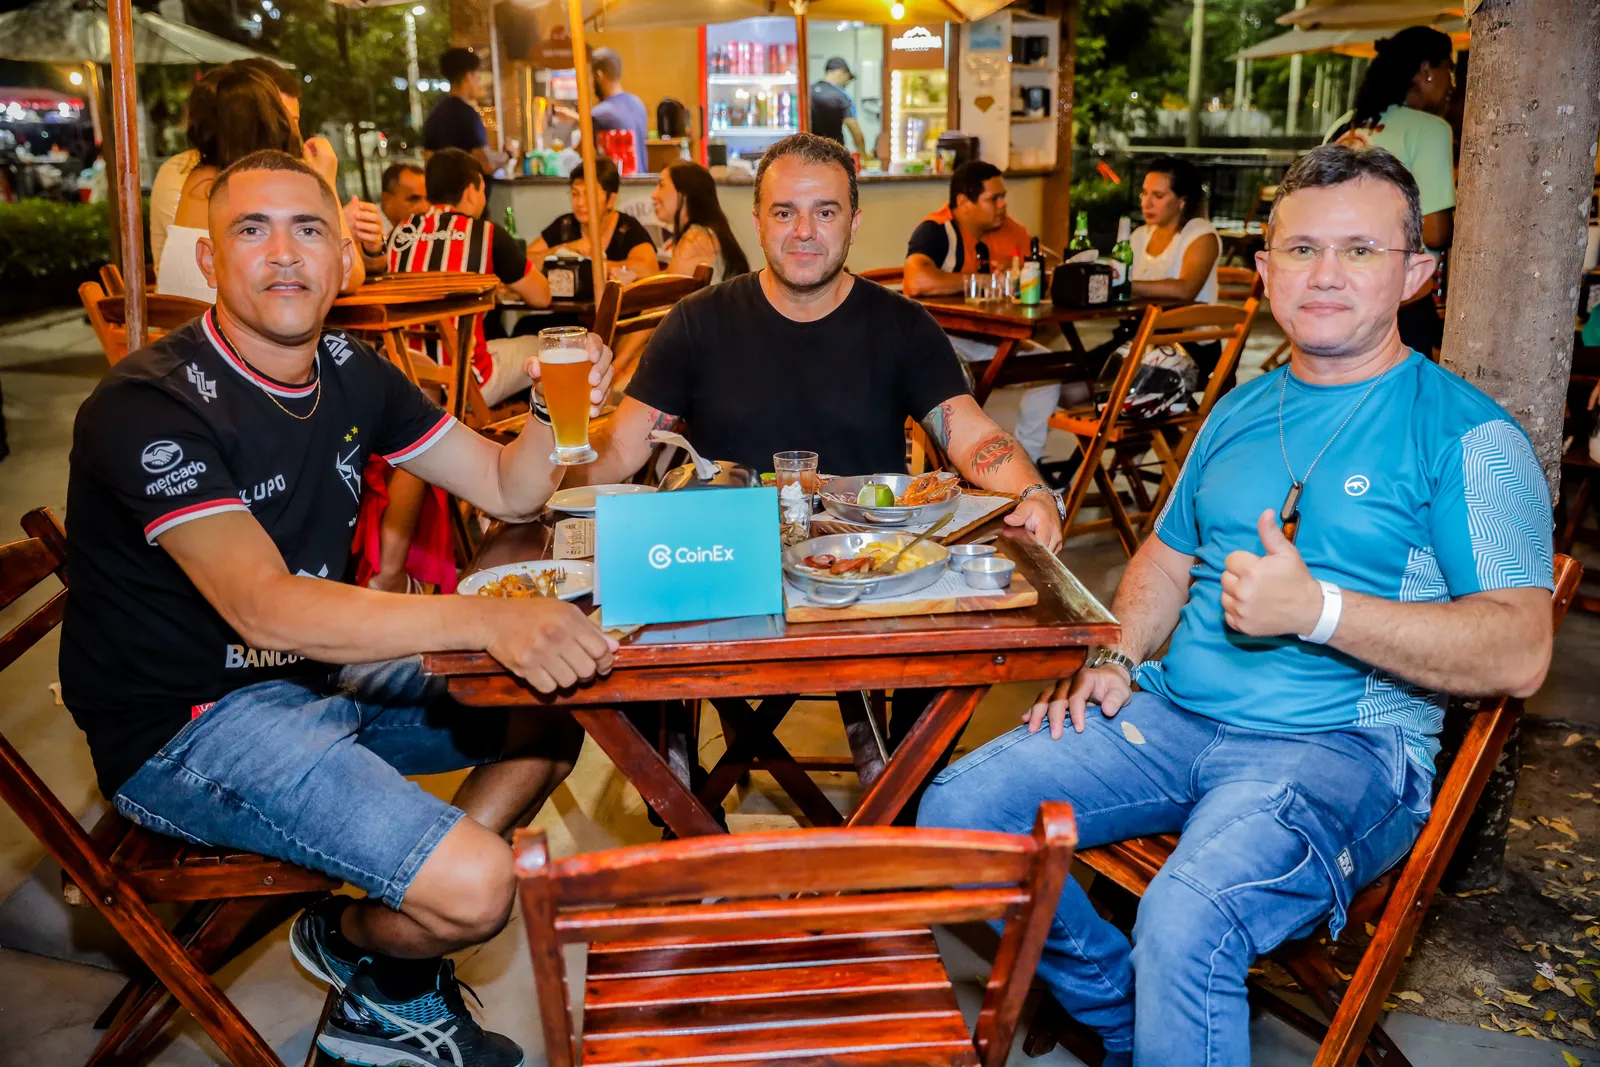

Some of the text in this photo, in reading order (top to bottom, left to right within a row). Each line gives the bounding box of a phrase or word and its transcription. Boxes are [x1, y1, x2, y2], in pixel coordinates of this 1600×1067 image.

[146, 461, 207, 495] mercado
[164, 478, 198, 496] livre
[675, 545, 734, 563] CoinEx
